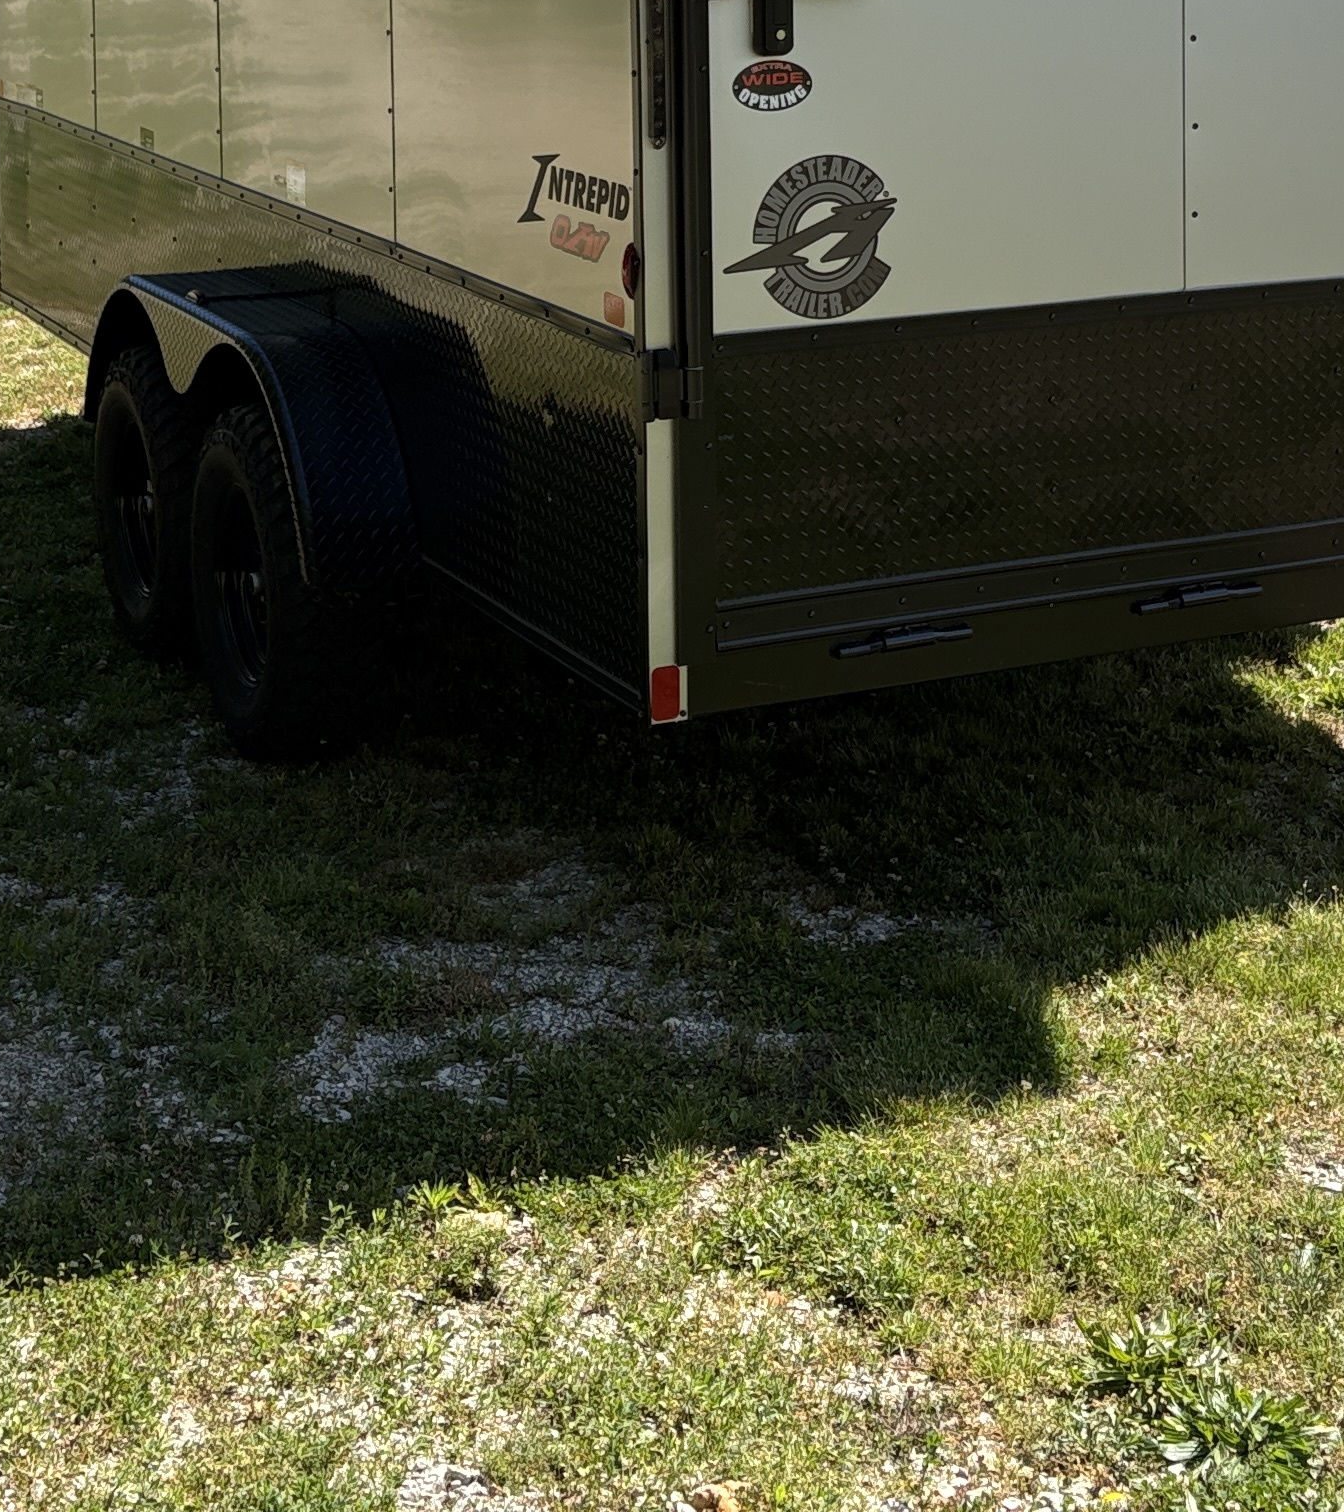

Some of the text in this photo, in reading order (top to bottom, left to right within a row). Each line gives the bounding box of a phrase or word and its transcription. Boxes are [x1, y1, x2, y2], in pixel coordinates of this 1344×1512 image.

[738, 85, 808, 109] OPENING
[742, 72, 804, 86] WIDE
[517, 154, 630, 223] INTREPID
[754, 156, 883, 242] HOMESTEADER
[764, 257, 891, 317] TRAILER.COM
